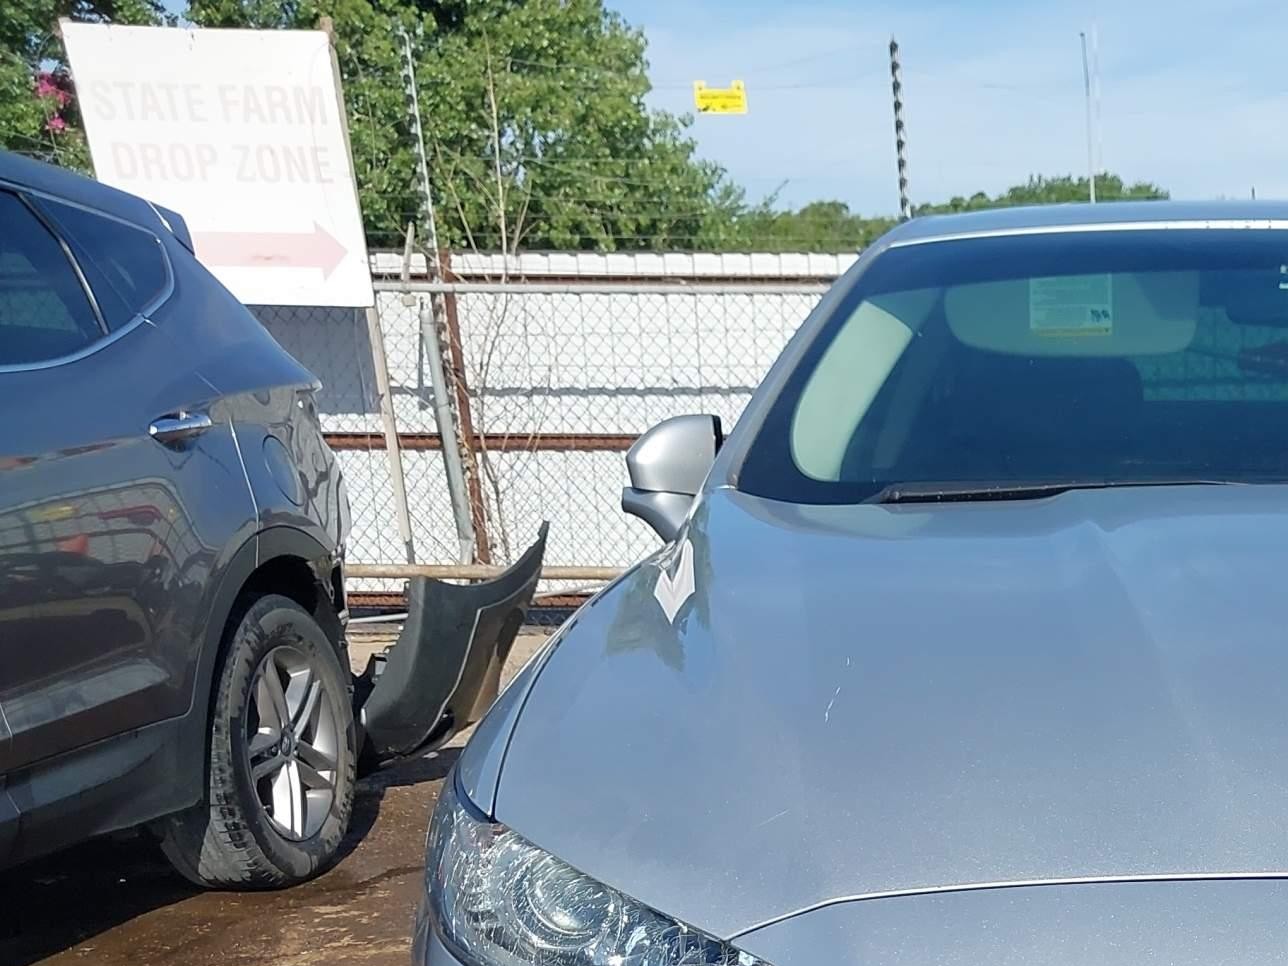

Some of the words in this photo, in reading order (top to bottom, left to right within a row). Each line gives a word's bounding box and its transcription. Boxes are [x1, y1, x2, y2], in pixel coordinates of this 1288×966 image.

[92, 81, 208, 122] STATE
[218, 84, 328, 126] FARM
[111, 142, 218, 182] DROP
[232, 145, 335, 184] ZONE
